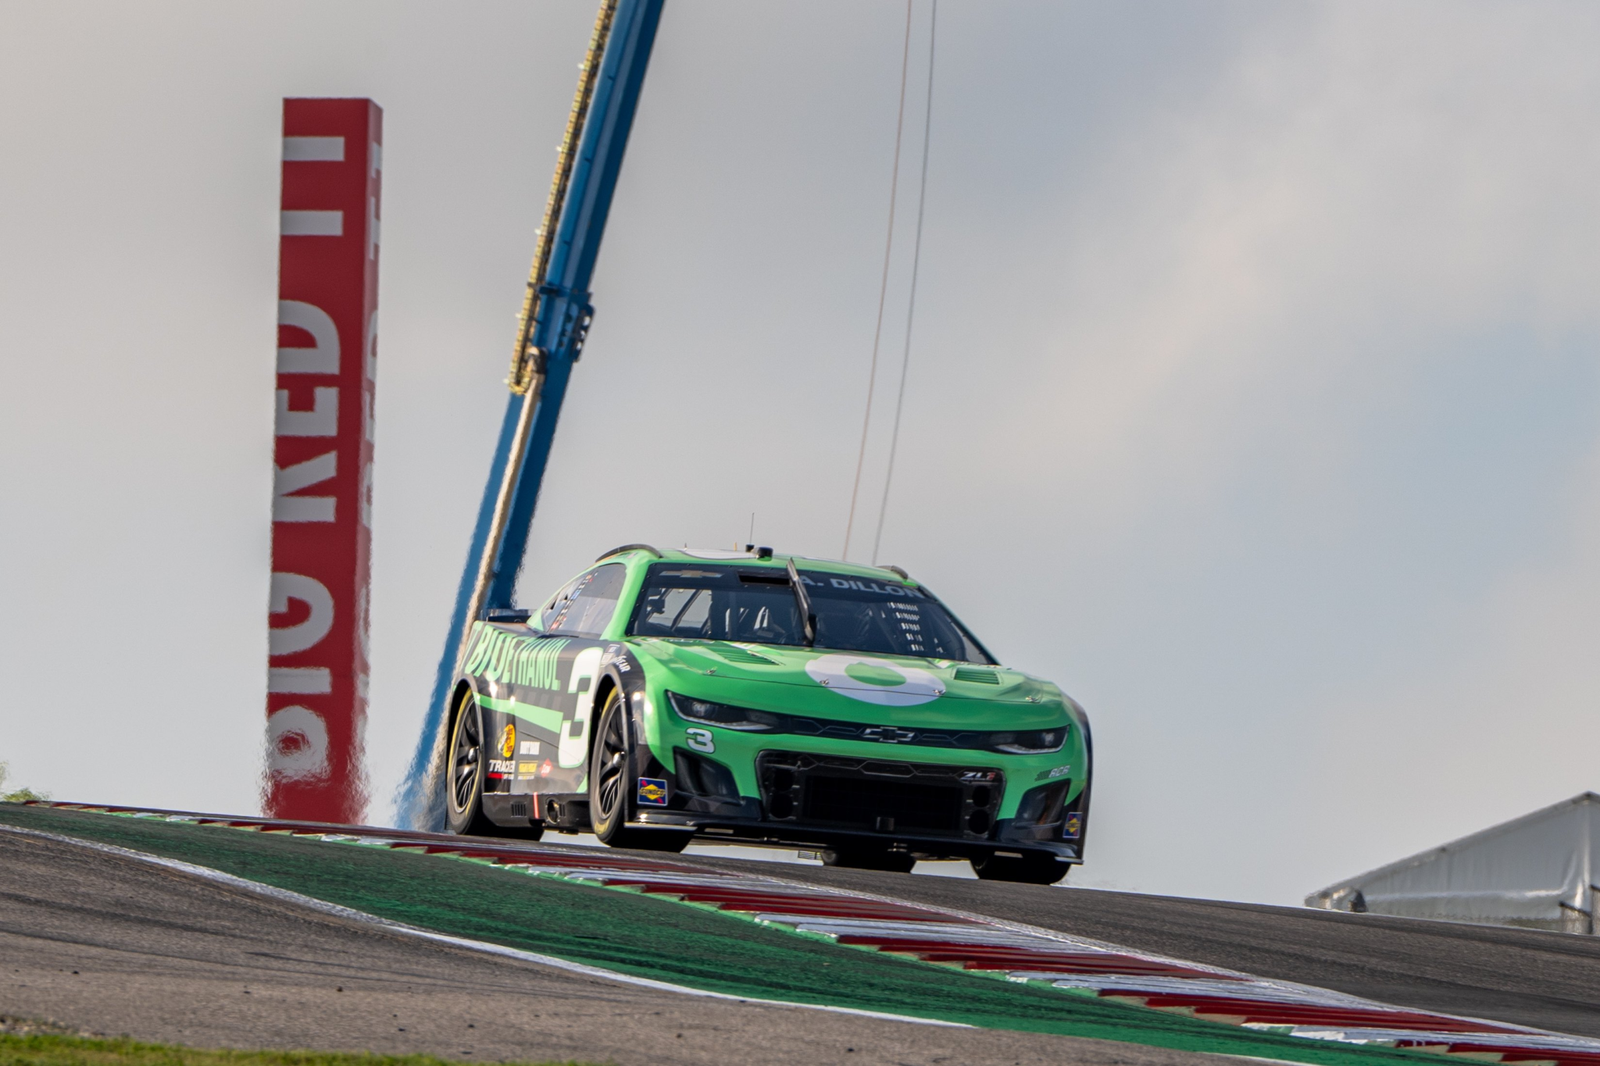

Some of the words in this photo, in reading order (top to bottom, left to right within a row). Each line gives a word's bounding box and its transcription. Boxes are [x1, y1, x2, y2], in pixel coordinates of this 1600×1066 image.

[829, 577, 925, 599] DILLON
[558, 646, 604, 769] 3
[685, 727, 715, 755] 3
[960, 771, 996, 781] ZL1
